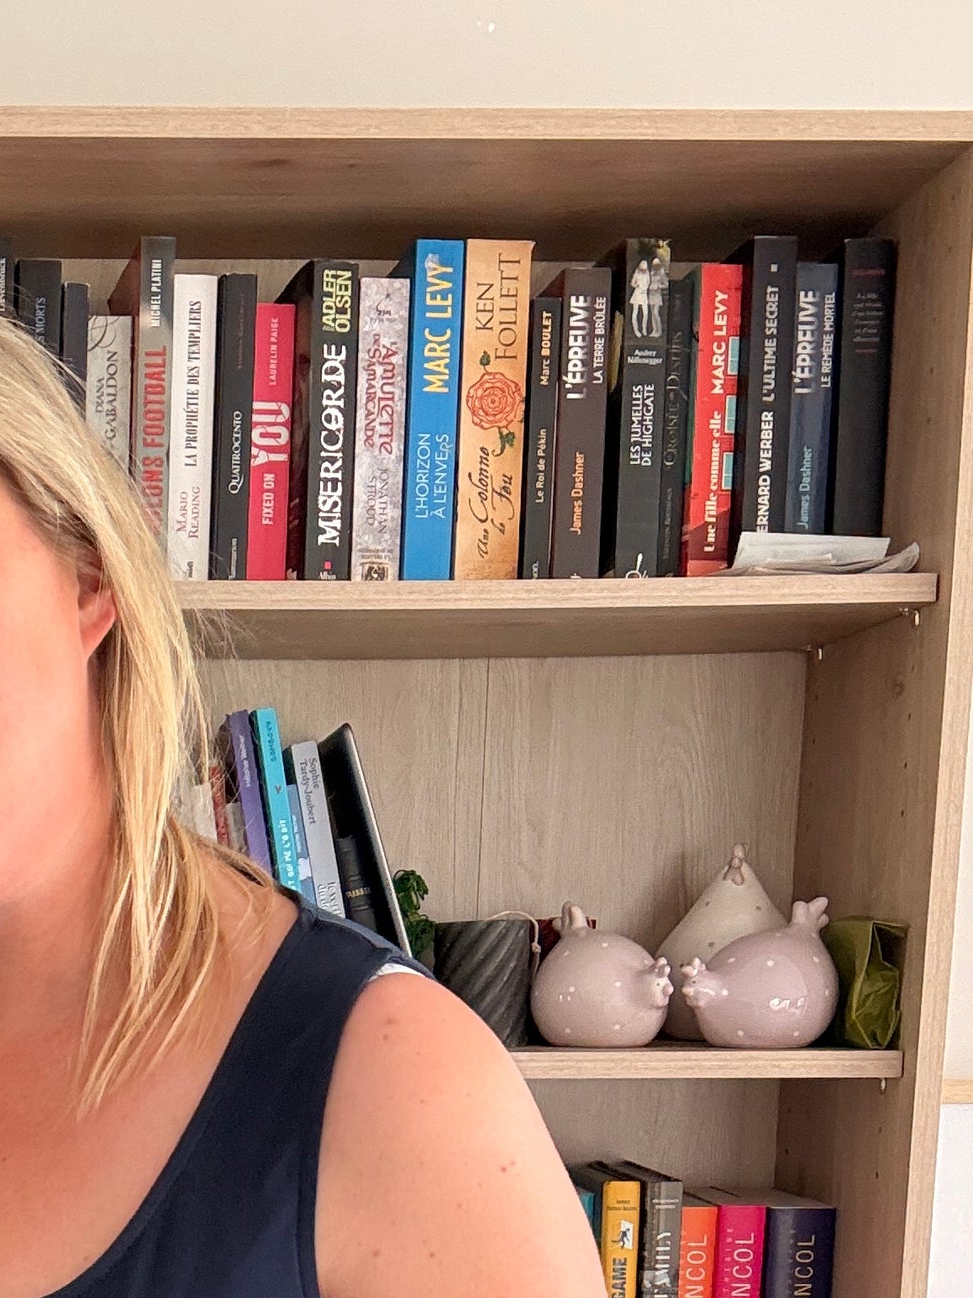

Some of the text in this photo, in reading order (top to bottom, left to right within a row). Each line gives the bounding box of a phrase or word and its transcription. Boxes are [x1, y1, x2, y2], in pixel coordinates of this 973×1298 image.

[150, 259, 162, 326] MICHEL PLATINI
[322, 270, 351, 333] ADLER OLSEN
[423, 264, 454, 392] MARC LEVY
[475, 253, 521, 361] KEN FOLLETT
[268, 318, 278, 385] LAURELIN PAIGE
[539, 311, 552, 385] Marc BOULET
[563, 295, 591, 399] L'ÉPREUVE
[592, 296, 607, 383] LA TERRE BRÛLÉE
[710, 290, 728, 394] MARC LEVY
[762, 285, 779, 401] L'ULTIME SECRET
[792, 290, 820, 394] L'ÉPREUVE
[95, 378, 104, 413] DIANA
[142, 345, 167, 447] FOOTBALL
[181, 300, 202, 467] LA PROPHÉTIE DES TEMPLIERS
[630, 385, 643, 464] LES JUMELLES
[642, 383, 655, 466] DE HIGHGATE
[250, 399, 291, 524] FIXED ON YOU
[318, 343, 347, 546] MISERICORDE
[415, 433, 430, 518] L'HORIZON
[430, 433, 453, 518] À L'ENVERS
[535, 429, 547, 503] Le Roi de Pékin
[758, 411, 774, 471] WERBER
[175, 486, 201, 539] MARIO READING
[569, 453, 584, 535] James Dashner
[796, 446, 812, 529] James Dashner
